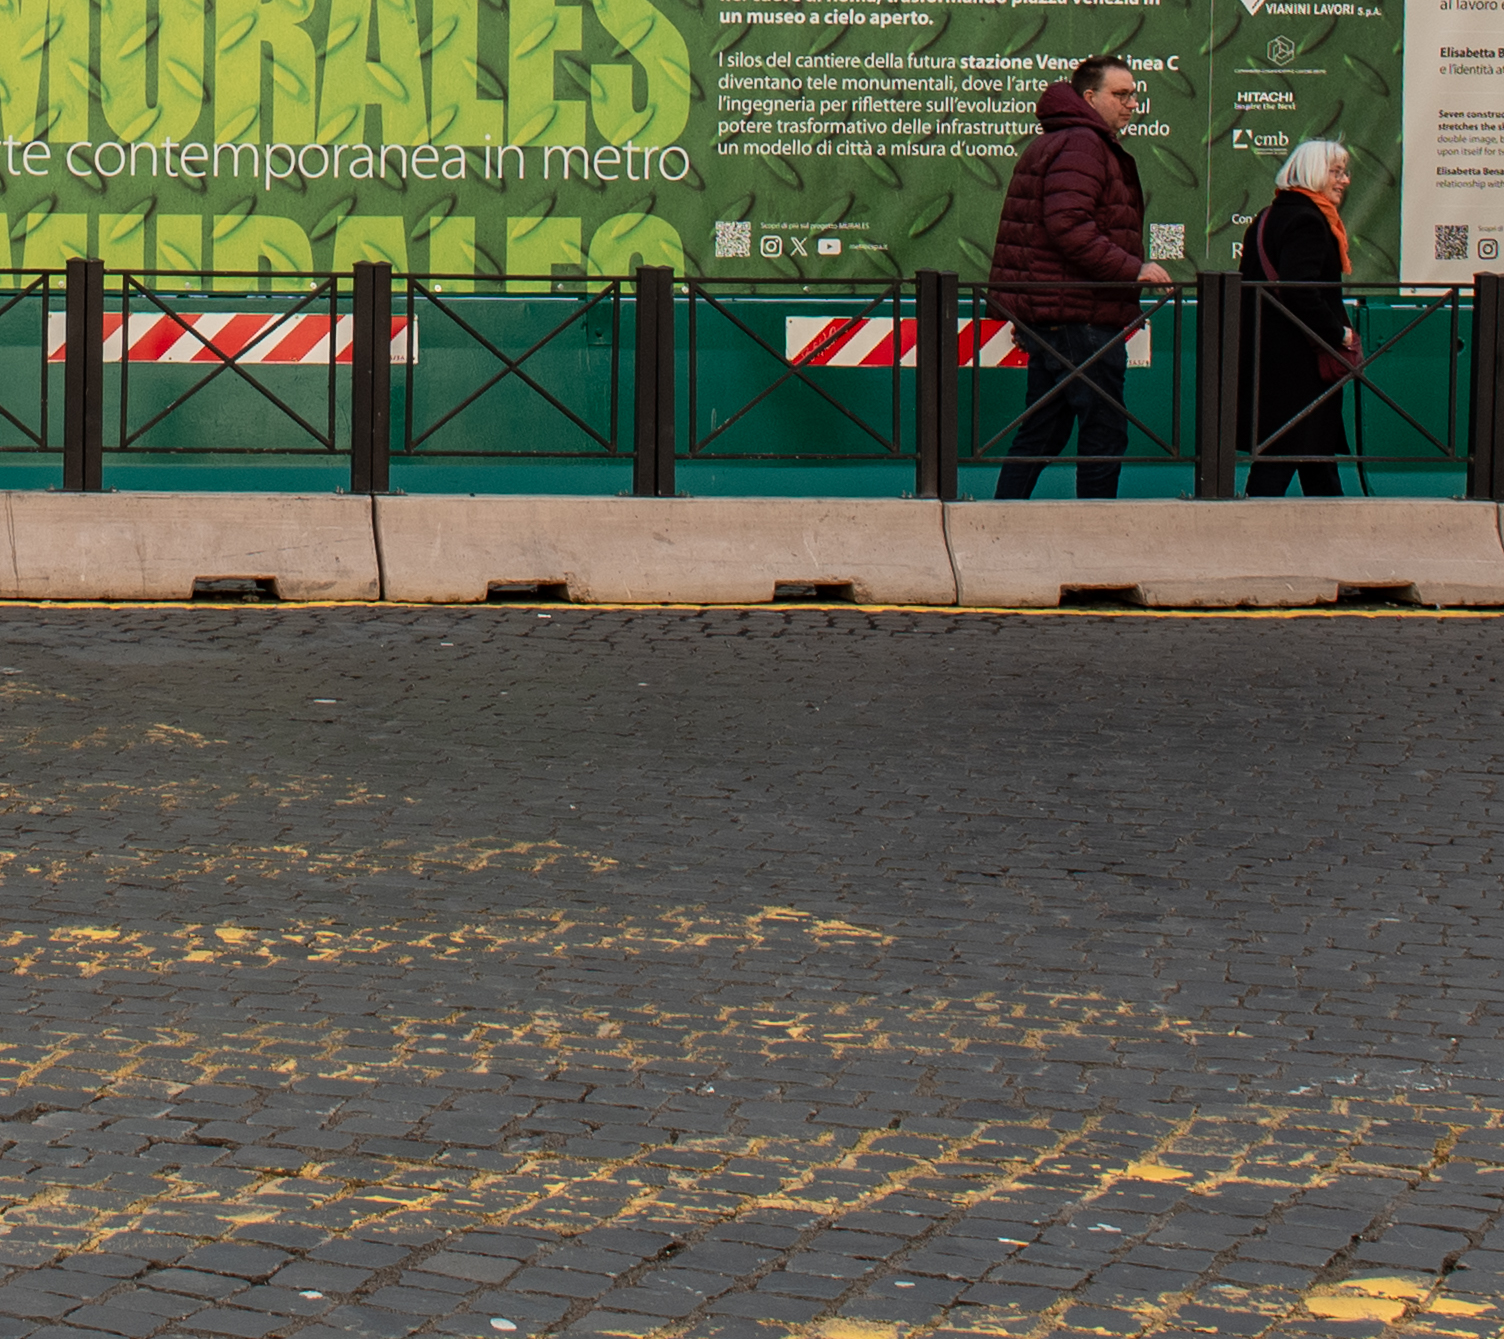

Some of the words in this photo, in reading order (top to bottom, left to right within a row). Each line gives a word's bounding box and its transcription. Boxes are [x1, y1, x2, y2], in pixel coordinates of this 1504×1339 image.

[719, 11, 742, 24] un
[746, 11, 806, 24] museo
[809, 12, 820, 24] a
[823, 8, 866, 25] cielo
[869, 10, 934, 29] aperto.
[1265, 3, 1310, 15] VIANINI
[1313, 3, 1354, 15] LAVORI
[1357, 7, 1381, 17] S.p.A.
[719, 51, 723, 67] I
[727, 51, 763, 68] silos
[765, 51, 791, 68] del
[795, 52, 861, 68] cantiere
[864, 52, 903, 69] della
[907, 52, 956, 69] futura
[959, 53, 1033, 70] stazione
[1167, 55, 1179, 71] C
[1237, 92, 1293, 102] HITACHI
[717, 142, 738, 155] un
[743, 138, 812, 156] modello
[816, 139, 832, 155] di
[836, 139, 872, 156] città
[876, 144, 886, 156] a
[891, 139, 946, 156] misura
[950, 140, 1018, 156] d'uomo.
[1254, 130, 1289, 146] cmb
[66, 135, 467, 190] contemporanea
[483, 133, 524, 180] in
[543, 138, 691, 182] metro
